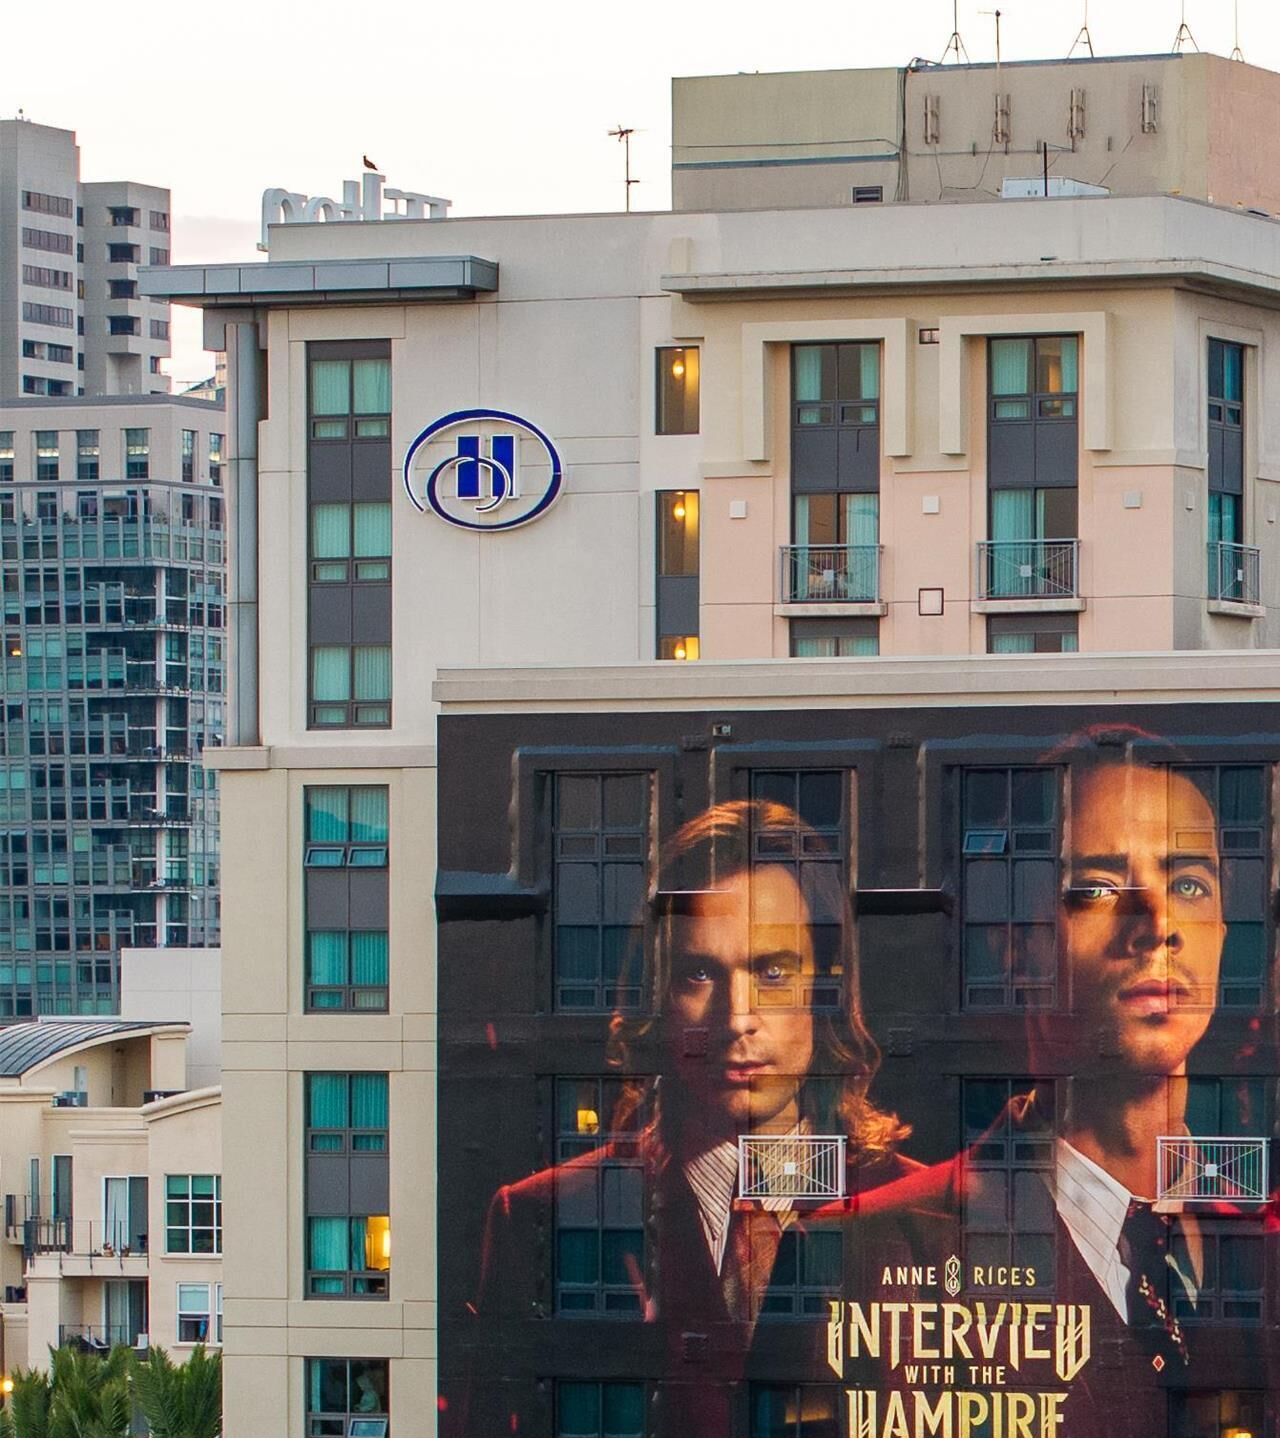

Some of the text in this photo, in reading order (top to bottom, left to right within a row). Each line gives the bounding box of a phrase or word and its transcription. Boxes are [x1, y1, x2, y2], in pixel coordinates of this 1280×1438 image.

[882, 1266, 1036, 1287] ANNE RICE'S
[827, 1301, 1091, 1381] INTERVIEW
[905, 1365, 1007, 1385] WITH THE
